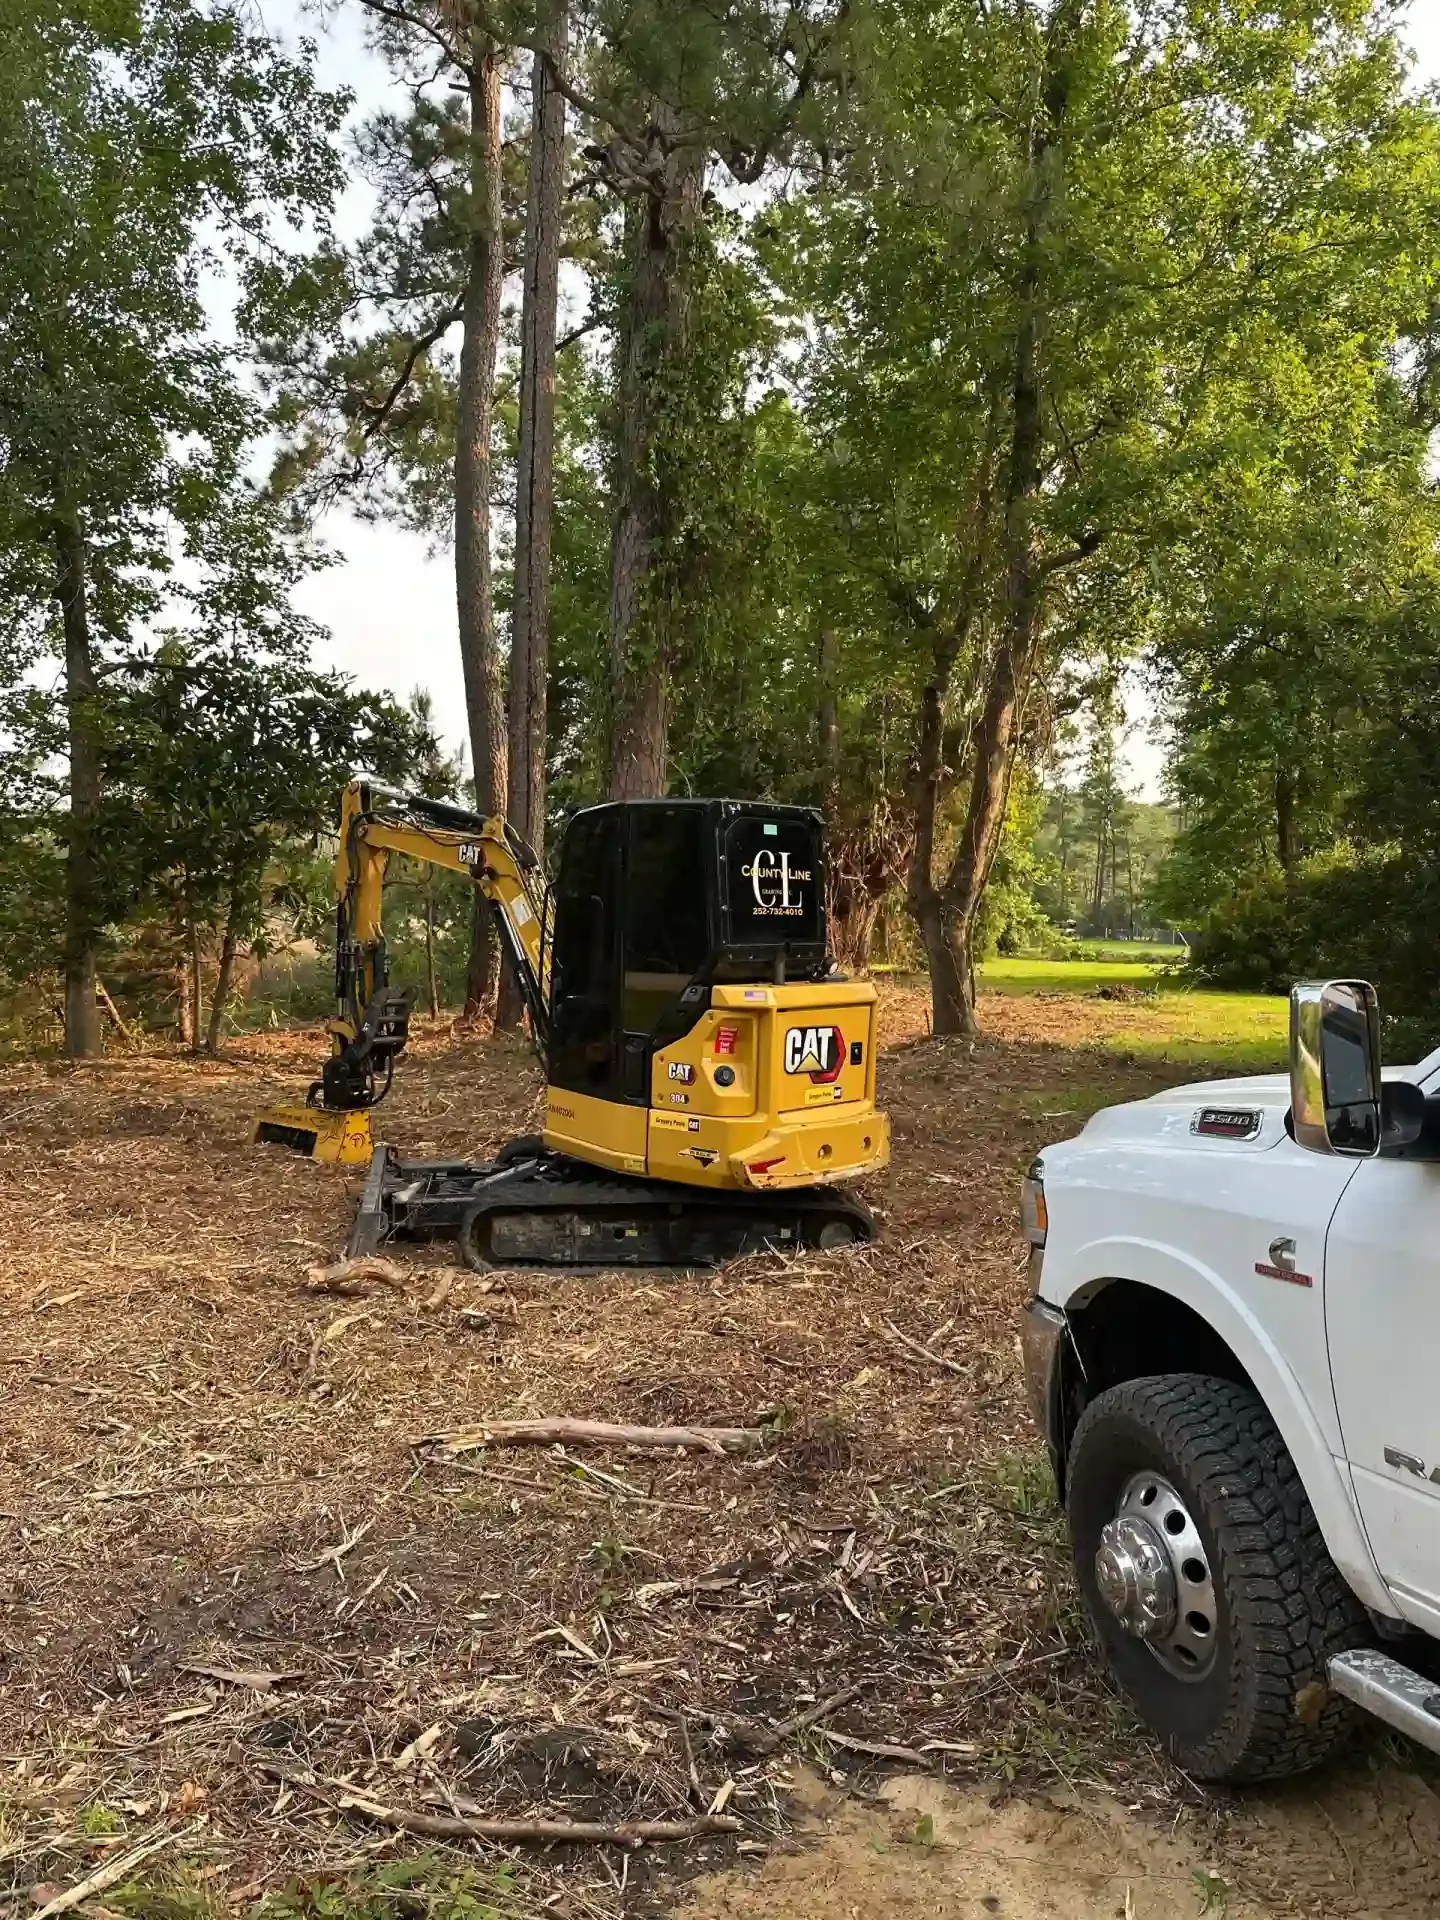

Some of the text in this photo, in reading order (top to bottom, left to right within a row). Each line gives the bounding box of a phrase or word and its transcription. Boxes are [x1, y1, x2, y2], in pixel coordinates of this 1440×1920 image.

[459, 844, 482, 865] CAT
[752, 849, 803, 908] CL
[788, 867, 812, 881] LINE
[752, 907, 804, 916] 252-732-4010
[784, 1027, 833, 1074] CAT
[668, 1062, 691, 1081] CAT
[670, 1094, 686, 1104] 304
[1203, 1113, 1250, 1126] 3500
